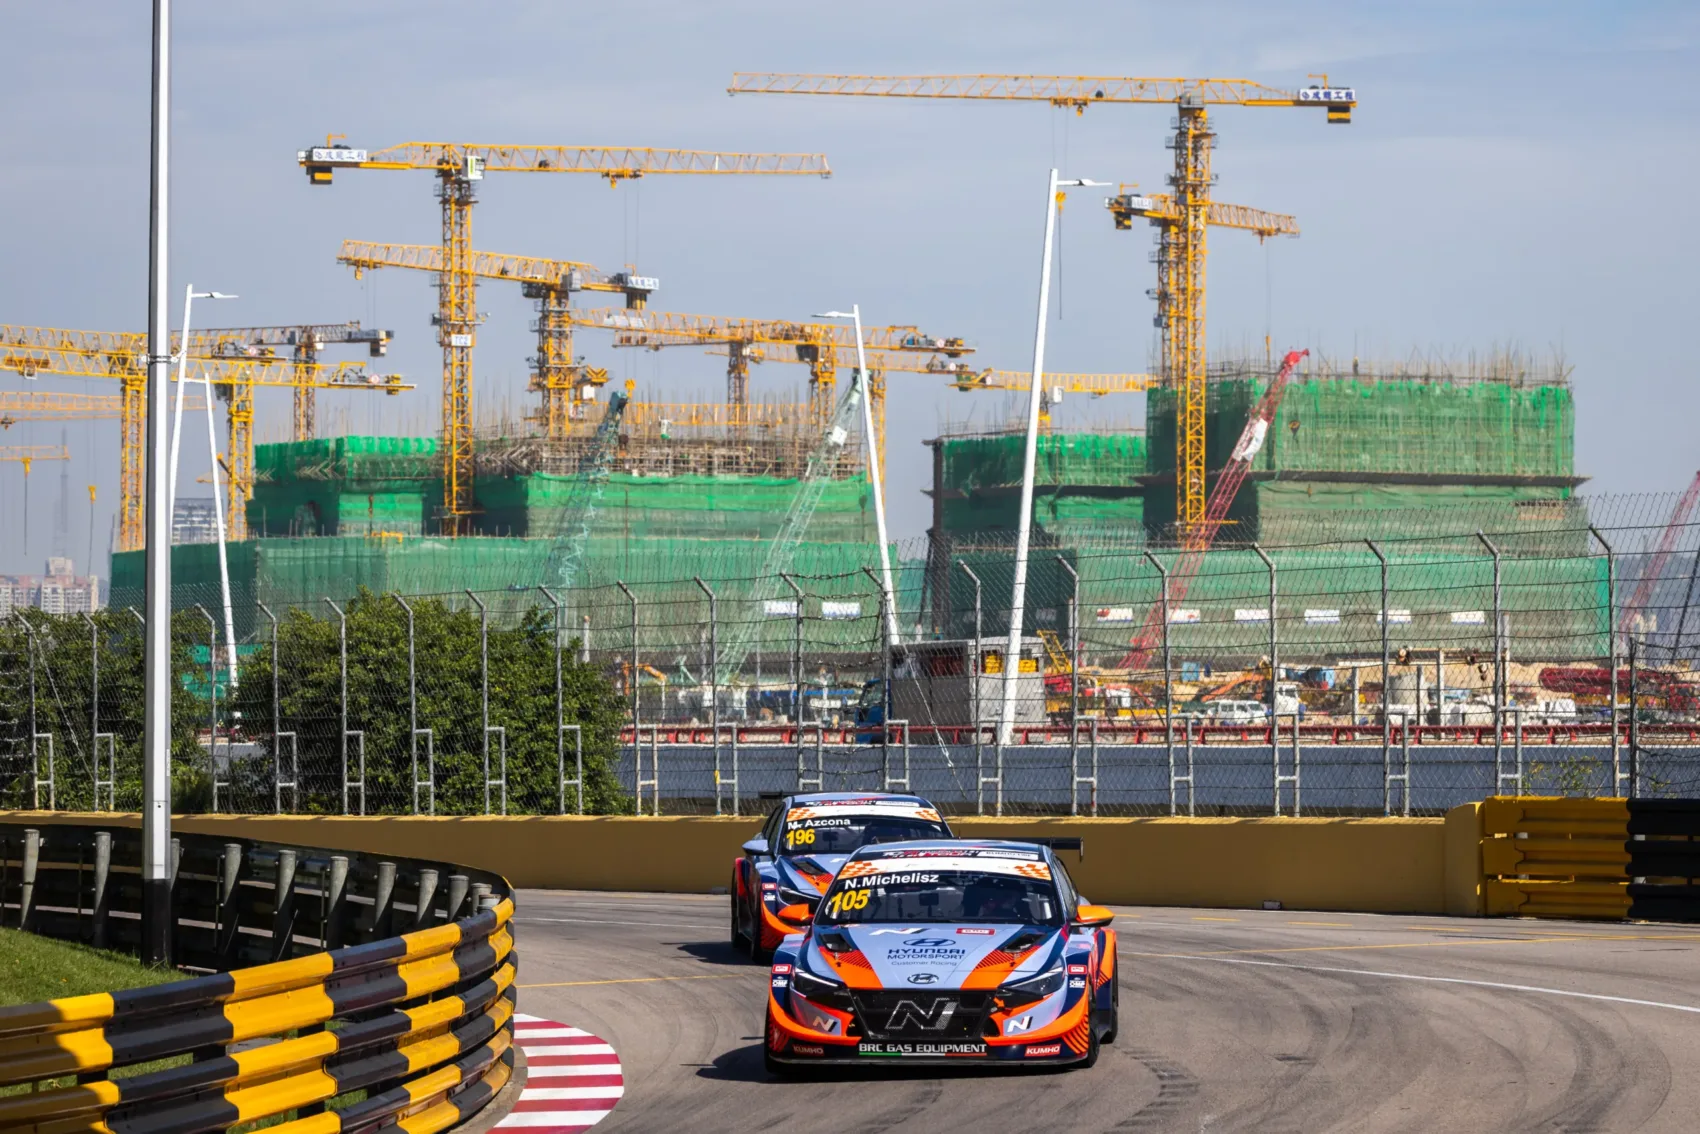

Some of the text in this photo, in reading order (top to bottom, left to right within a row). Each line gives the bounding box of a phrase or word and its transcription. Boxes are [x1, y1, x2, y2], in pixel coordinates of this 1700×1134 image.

[805, 818, 851, 828] Azcona
[786, 828, 815, 847] 196
[844, 872, 939, 890] N.Michelisz
[830, 888, 871, 913] 105
[793, 1045, 824, 1055] KUMHO
[859, 1043, 987, 1053] BRC GAS EQUIPMENT
[1026, 1045, 1060, 1055] KUMHO
